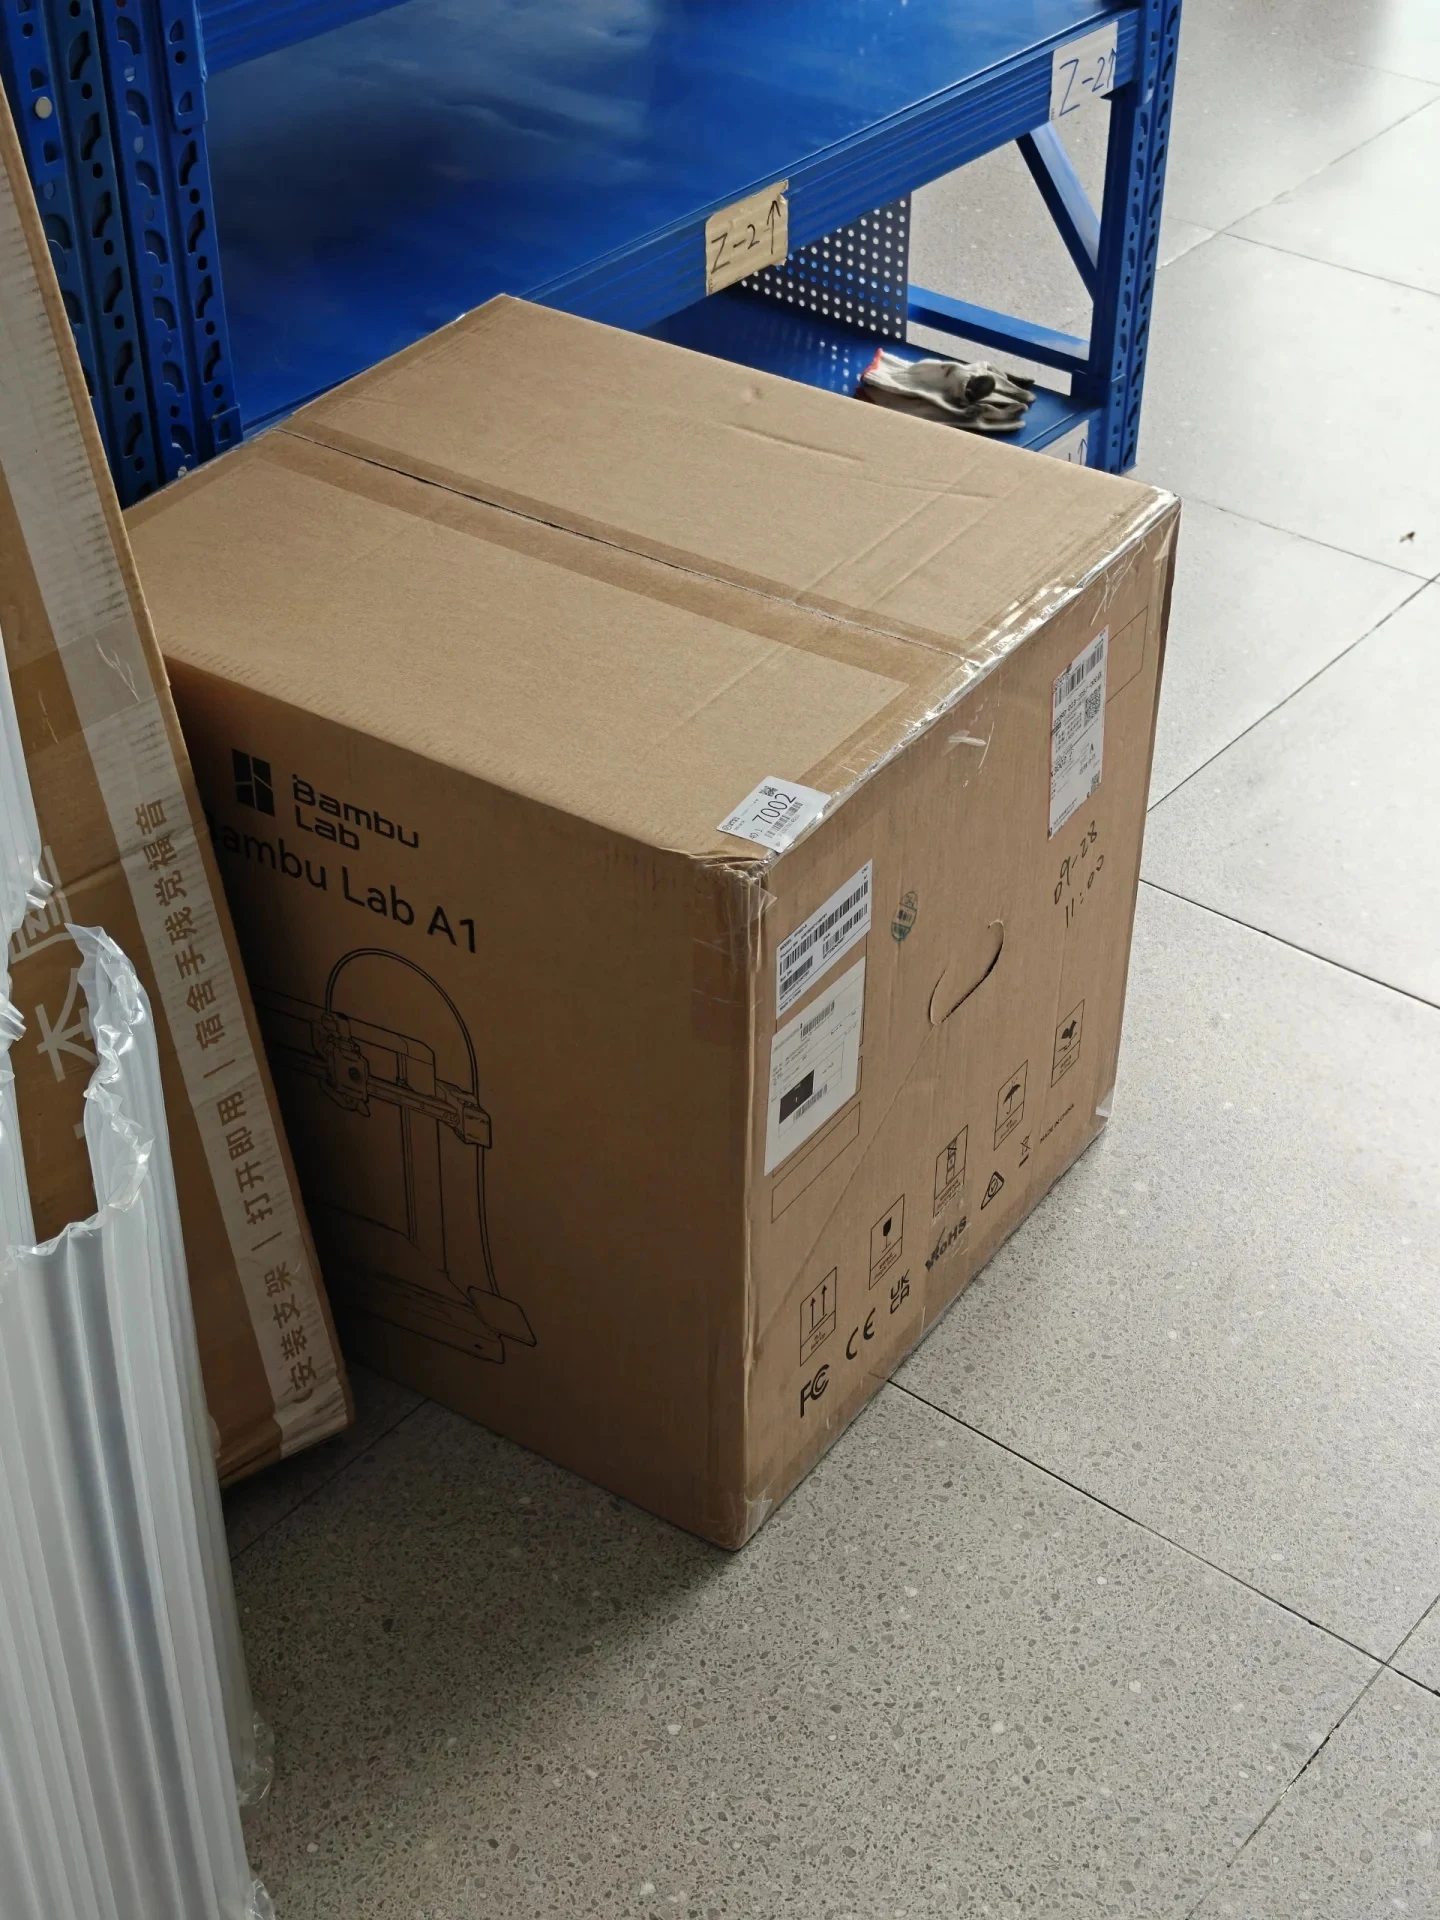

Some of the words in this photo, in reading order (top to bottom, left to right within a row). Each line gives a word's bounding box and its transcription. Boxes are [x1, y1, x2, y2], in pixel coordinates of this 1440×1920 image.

[711, 223, 760, 274] Z-2
[292, 773, 419, 849] Bambu
[294, 804, 360, 850] Lab
[751, 793, 797, 825] 7002
[135, 799, 226, 1050] 宿舍手残党福音
[341, 865, 415, 926] Lab
[426, 904, 477, 955] A1
[216, 1090, 273, 1226] 打开即用
[845, 1306, 876, 1361] CE
